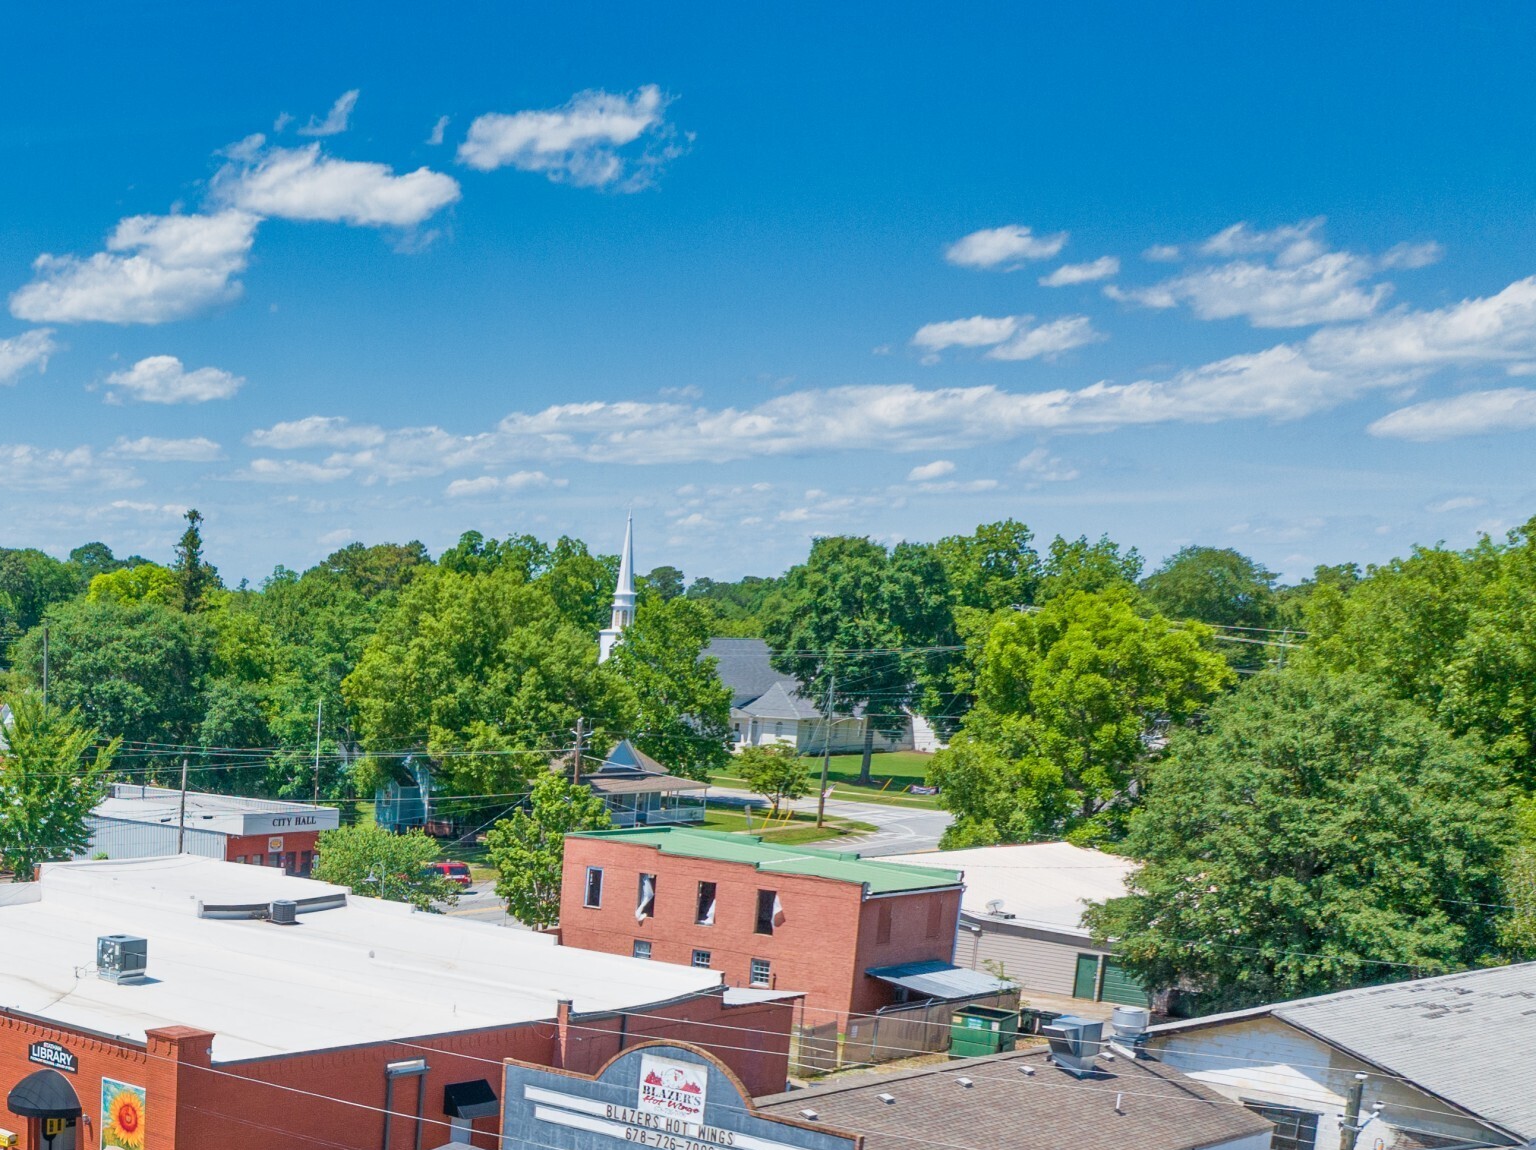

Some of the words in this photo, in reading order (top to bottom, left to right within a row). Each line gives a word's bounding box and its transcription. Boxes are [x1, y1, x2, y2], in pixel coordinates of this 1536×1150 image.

[272, 816, 292, 827] CITY
[295, 816, 316, 826] HALL
[32, 1044, 73, 1066] LIBRARY
[642, 1085, 702, 1106] BLAZER'S
[606, 1104, 660, 1129] BLAZERS
[665, 1118, 688, 1135] HOT
[698, 1123, 734, 1145] WINGS
